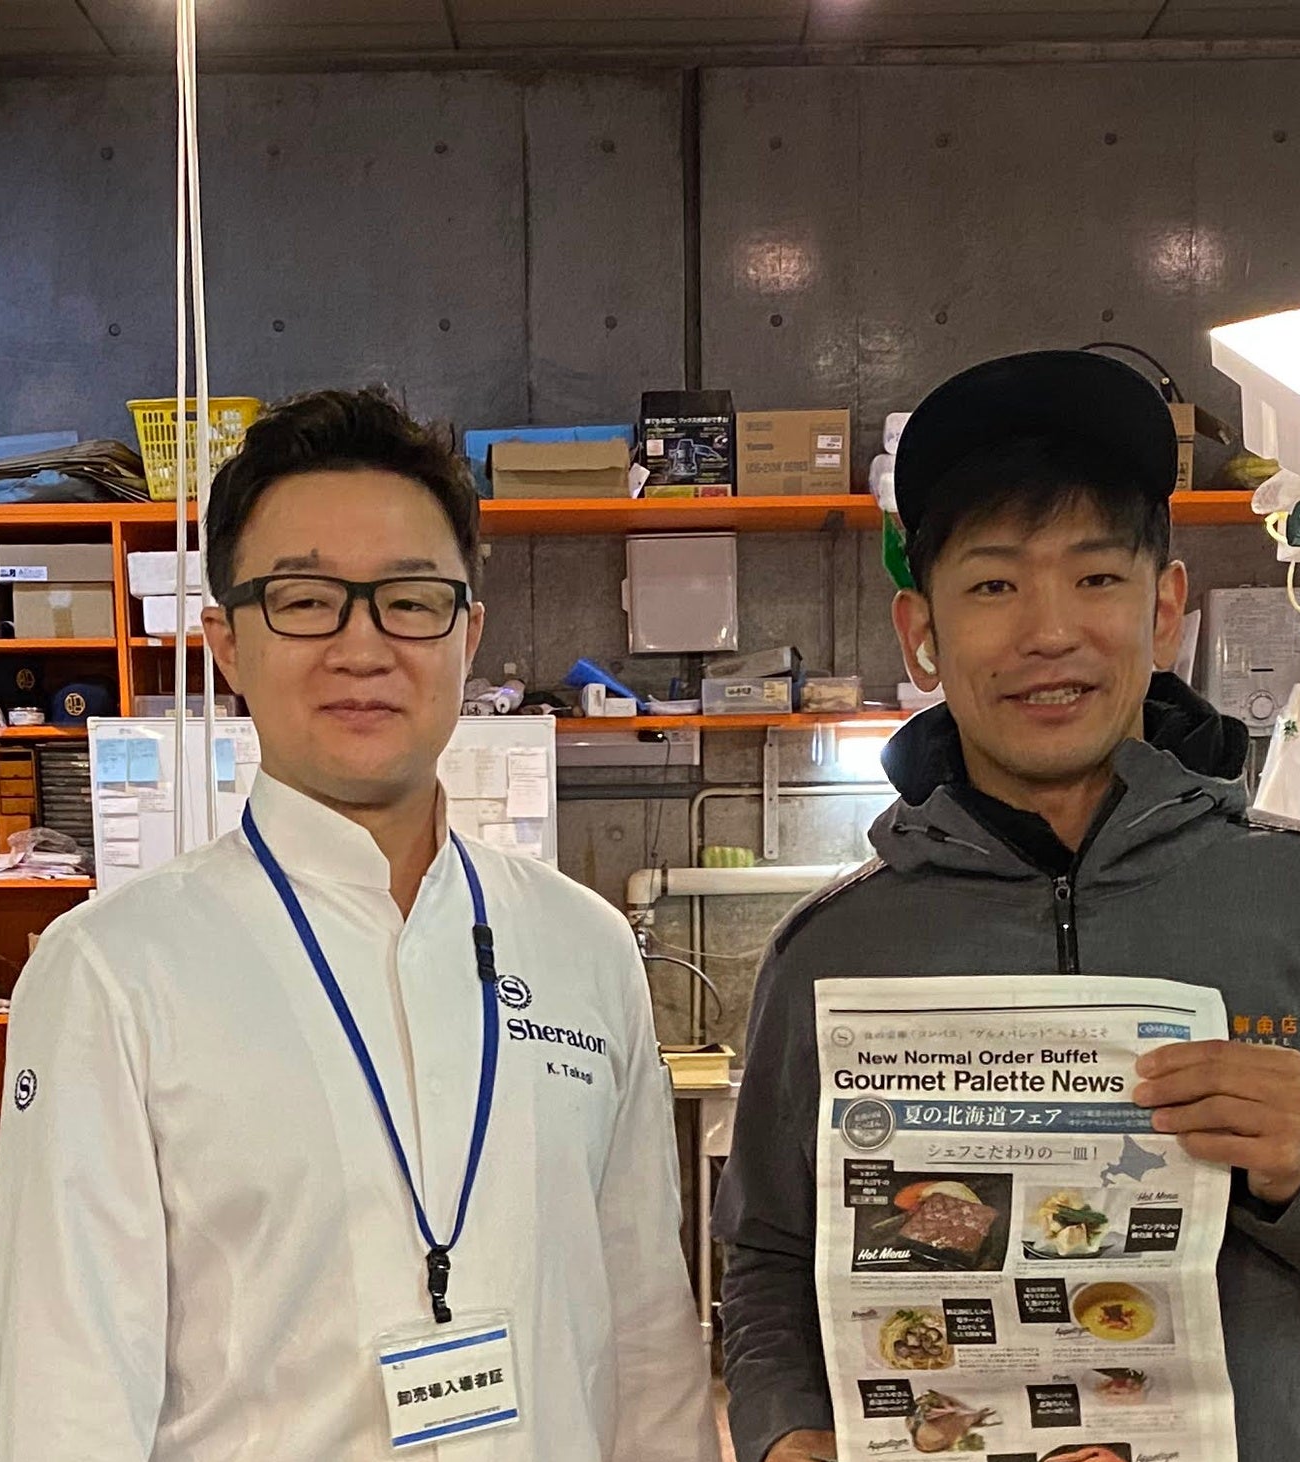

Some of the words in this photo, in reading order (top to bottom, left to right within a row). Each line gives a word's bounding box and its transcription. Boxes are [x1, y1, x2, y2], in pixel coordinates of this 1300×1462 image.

[507, 1018, 606, 1055] Sheraton
[858, 1051, 897, 1064] New
[905, 1051, 971, 1064] Normal
[979, 1050, 1034, 1065] Order
[1041, 1049, 1098, 1064] Buffet
[834, 1070, 945, 1091] Gourmet
[954, 1070, 1045, 1092] Palette
[1052, 1070, 1124, 1092] News
[904, 1105, 1062, 1126] 夏の北海道フェア
[858, 1250, 878, 1261] Hot
[879, 1247, 911, 1260] Menu
[397, 1368, 504, 1407] 卸売場入場者証
